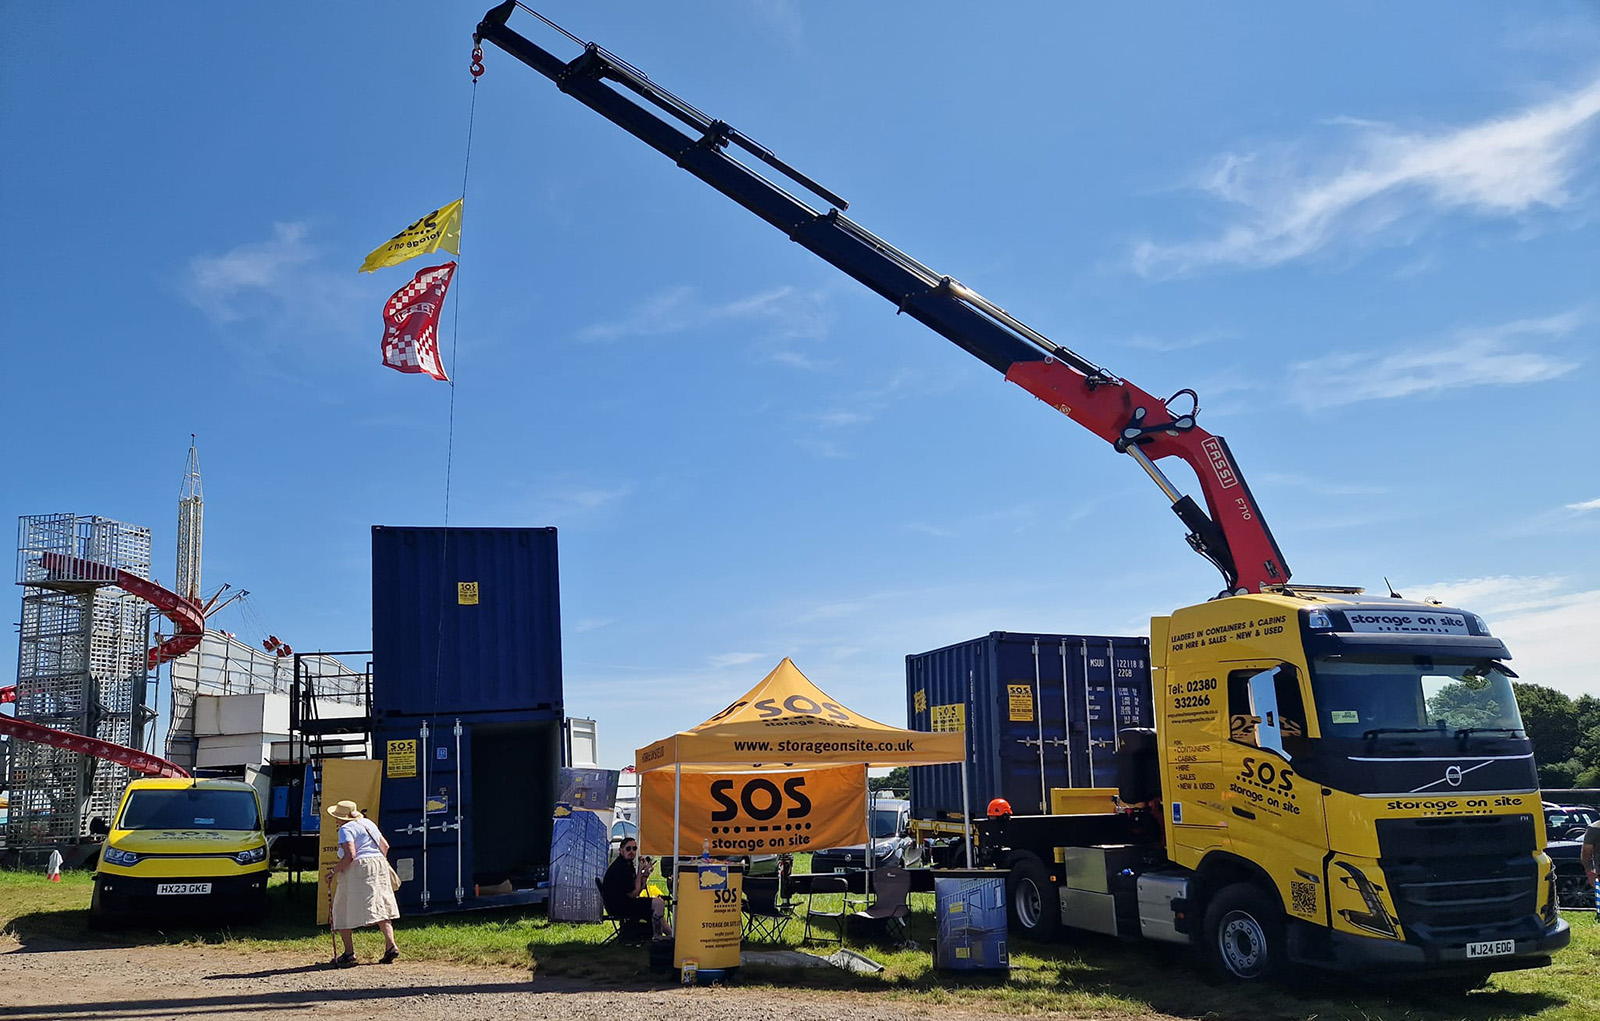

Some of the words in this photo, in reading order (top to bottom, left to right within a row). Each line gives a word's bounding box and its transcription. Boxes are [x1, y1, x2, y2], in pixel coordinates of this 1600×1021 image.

[1205, 442, 1234, 484] FASSI
[1234, 497, 1252, 521] F710
[1351, 614, 1412, 626] storage
[1417, 616, 1436, 625] on
[1440, 616, 1464, 627] site
[1171, 632, 1195, 643] LEADERS
[1205, 622, 1246, 636] CONTAINERS
[1249, 620, 1254, 628] &
[1257, 615, 1287, 627] CABINS
[1172, 643, 1184, 652] FOR
[1185, 641, 1199, 650] HIRE
[1201, 639, 1206, 647] &
[1208, 635, 1227, 645] SALES
[1236, 631, 1252, 640] NEW
[1255, 629, 1260, 637] &
[1264, 626, 1284, 636] USED
[1116, 659, 1137, 668] 122118
[1168, 683, 1184, 695] Tel:
[1186, 677, 1217, 693] 02380
[754, 694, 850, 721] SOS
[1174, 694, 1211, 709] 332266
[765, 719, 815, 727] storage
[837, 722, 859, 730] site
[390, 742, 414, 750] SOS
[734, 740, 774, 751] www.
[777, 739, 915, 754] storageonsite.co.uk
[1177, 745, 1211, 753] CONTAINERS
[1178, 764, 1190, 772] HIRE
[1241, 757, 1294, 791] SOS
[1179, 773, 1197, 781] SALES
[1180, 782, 1192, 790] NEW
[1199, 782, 1215, 790] USED
[710, 776, 812, 822] SOS
[1229, 783, 1264, 802] storage
[1266, 797, 1279, 808] on
[1282, 801, 1301, 815] site
[1387, 800, 1459, 811] storage
[1466, 799, 1488, 807] on
[1494, 796, 1523, 807] site
[711, 838, 765, 852] storage
[769, 838, 785, 847] on
[789, 833, 811, 847] site
[161, 884, 187, 894] HX23
[189, 884, 208, 893] GKE
[714, 888, 737, 904] SOS
[1495, 941, 1512, 954] EOG
